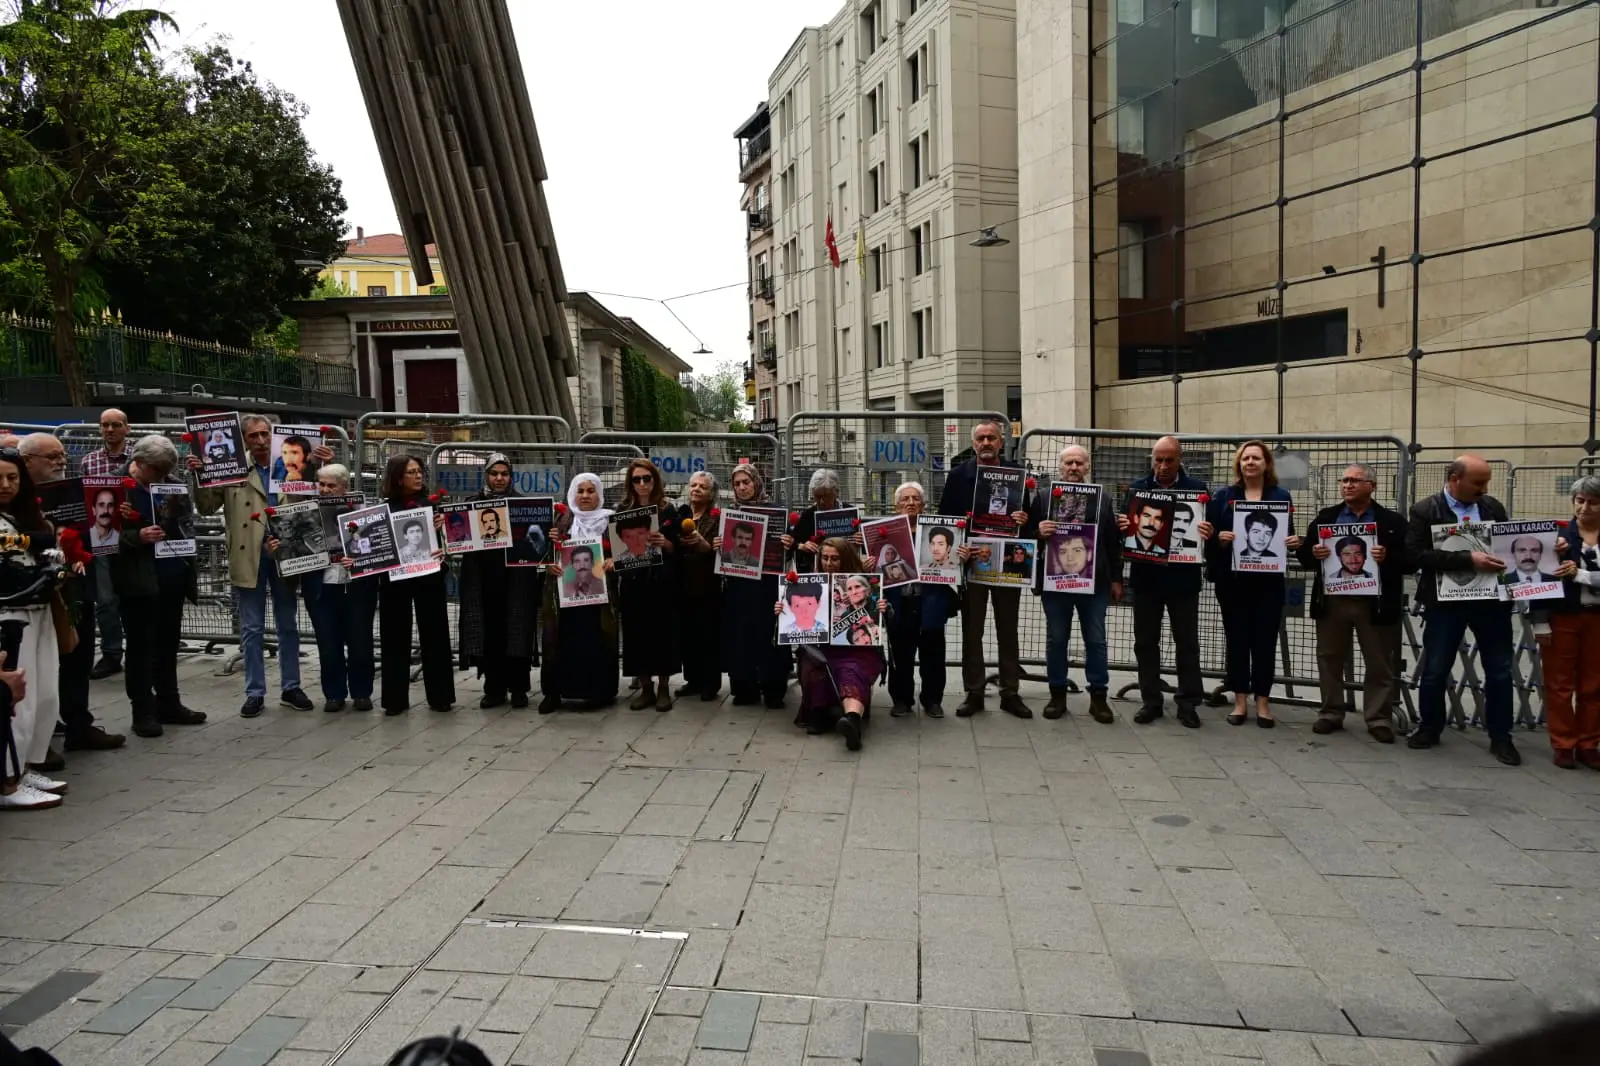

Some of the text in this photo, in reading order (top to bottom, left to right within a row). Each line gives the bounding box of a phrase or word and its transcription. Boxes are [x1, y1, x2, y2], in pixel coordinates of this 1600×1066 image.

[376, 320, 454, 330] GALATASARAY
[189, 421, 209, 432] BERFO
[874, 438, 926, 463] POLİS
[650, 454, 705, 473] POLİS
[512, 468, 560, 493] POLİS
[1004, 474, 1020, 482] KURT
[1136, 491, 1151, 499] AGİT
[918, 516, 942, 525] MURAT
[1326, 580, 1377, 593] KAYBEDİLDİ
[1513, 584, 1558, 598] AYBEDİLDİ
